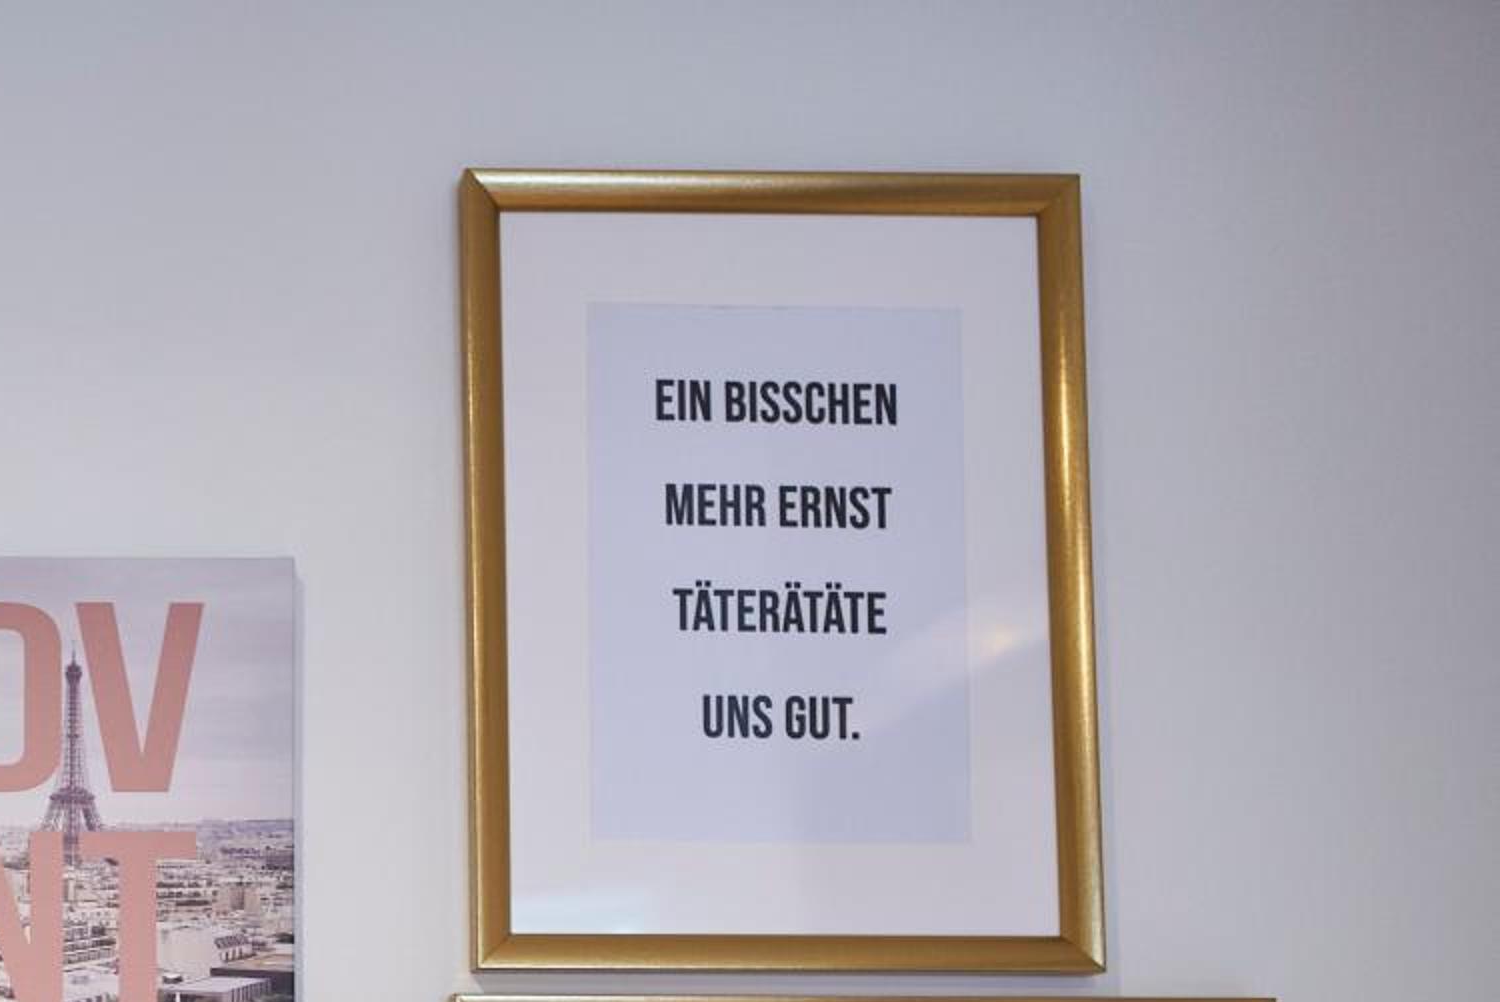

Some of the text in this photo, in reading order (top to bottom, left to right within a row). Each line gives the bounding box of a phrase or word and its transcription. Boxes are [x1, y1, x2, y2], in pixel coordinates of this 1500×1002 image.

[655, 379, 898, 426] EIN BISSCHEN
[665, 483, 893, 529] MEHR ERNST
[672, 579, 888, 635] TÄTERÄTÄTE
[702, 695, 861, 740] UNS GUT.
